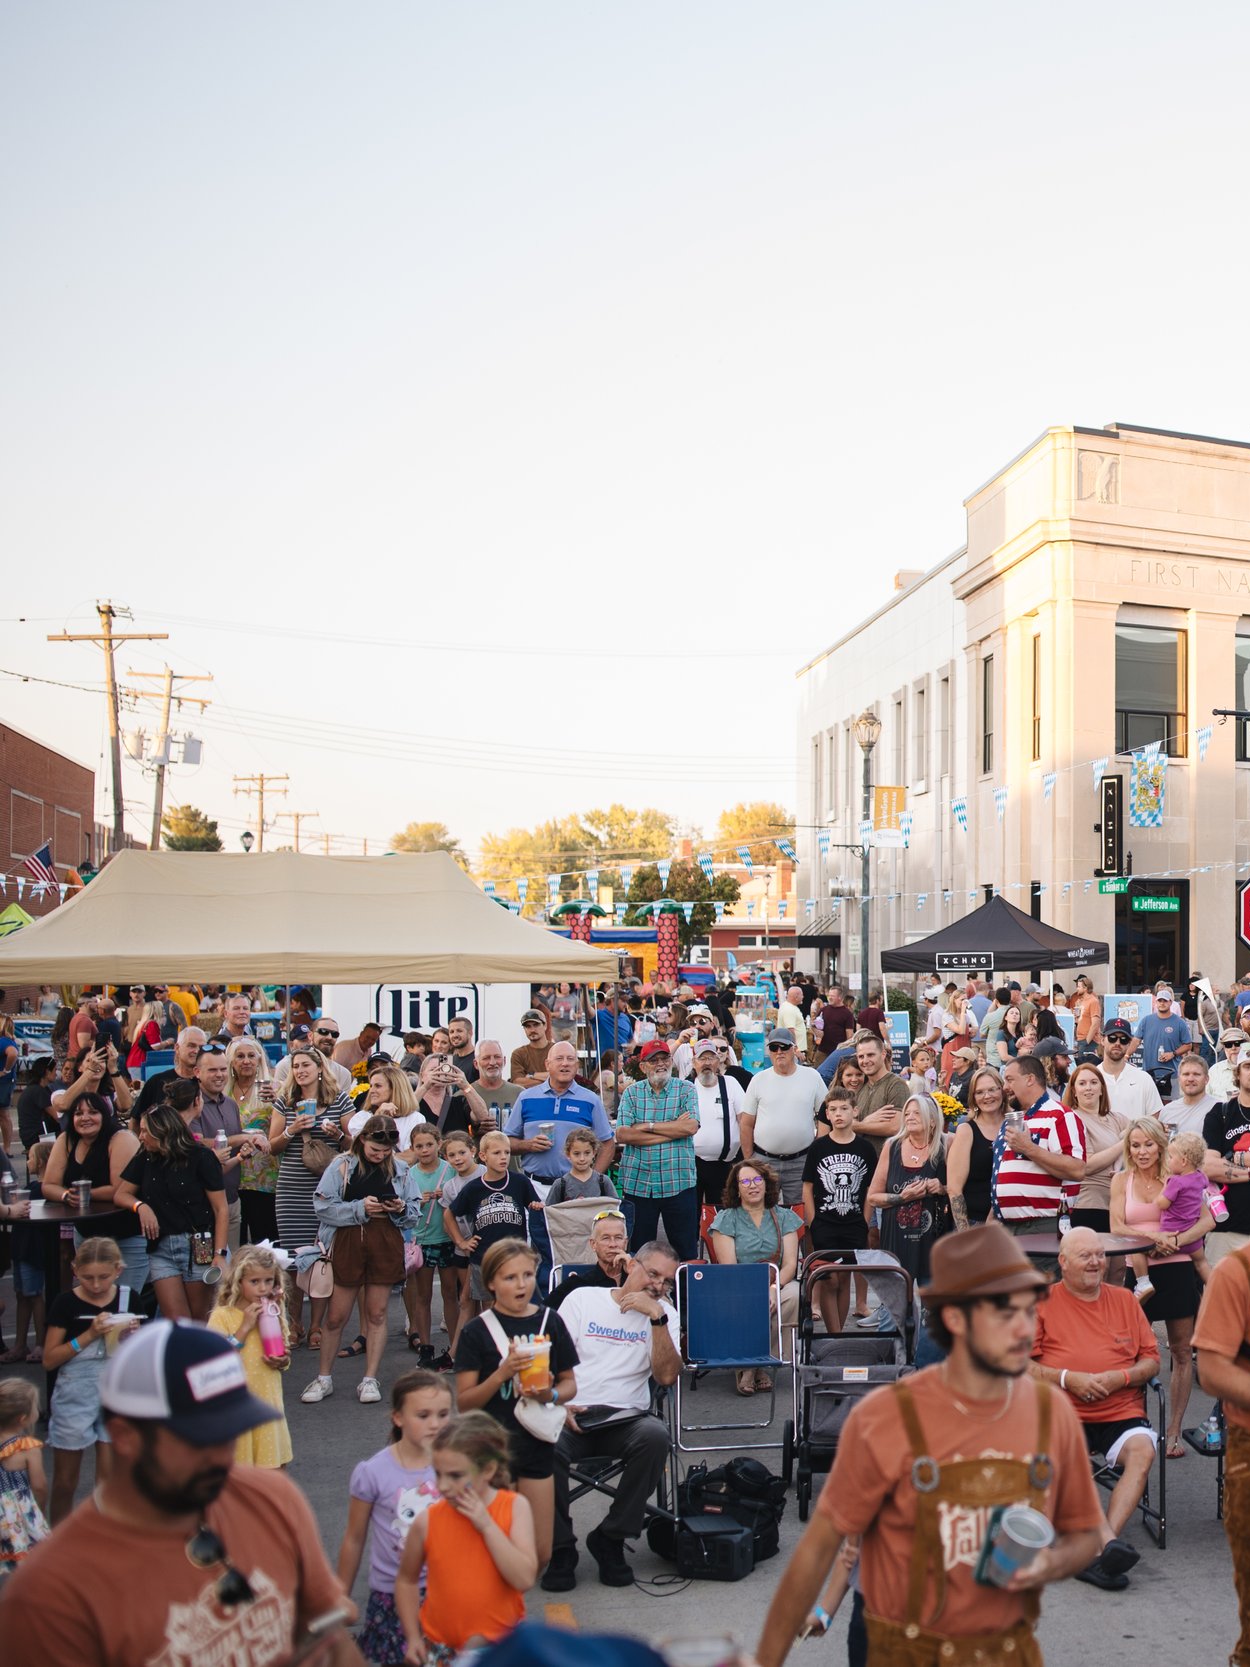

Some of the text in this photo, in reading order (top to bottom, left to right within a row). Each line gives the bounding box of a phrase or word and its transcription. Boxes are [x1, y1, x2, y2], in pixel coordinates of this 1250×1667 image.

[1130, 560, 1200, 588] FIRST
[1140, 898, 1168, 910] Jefferson
[1169, 902, 1178, 910] Ave
[821, 1153, 865, 1167] FREEDOM
